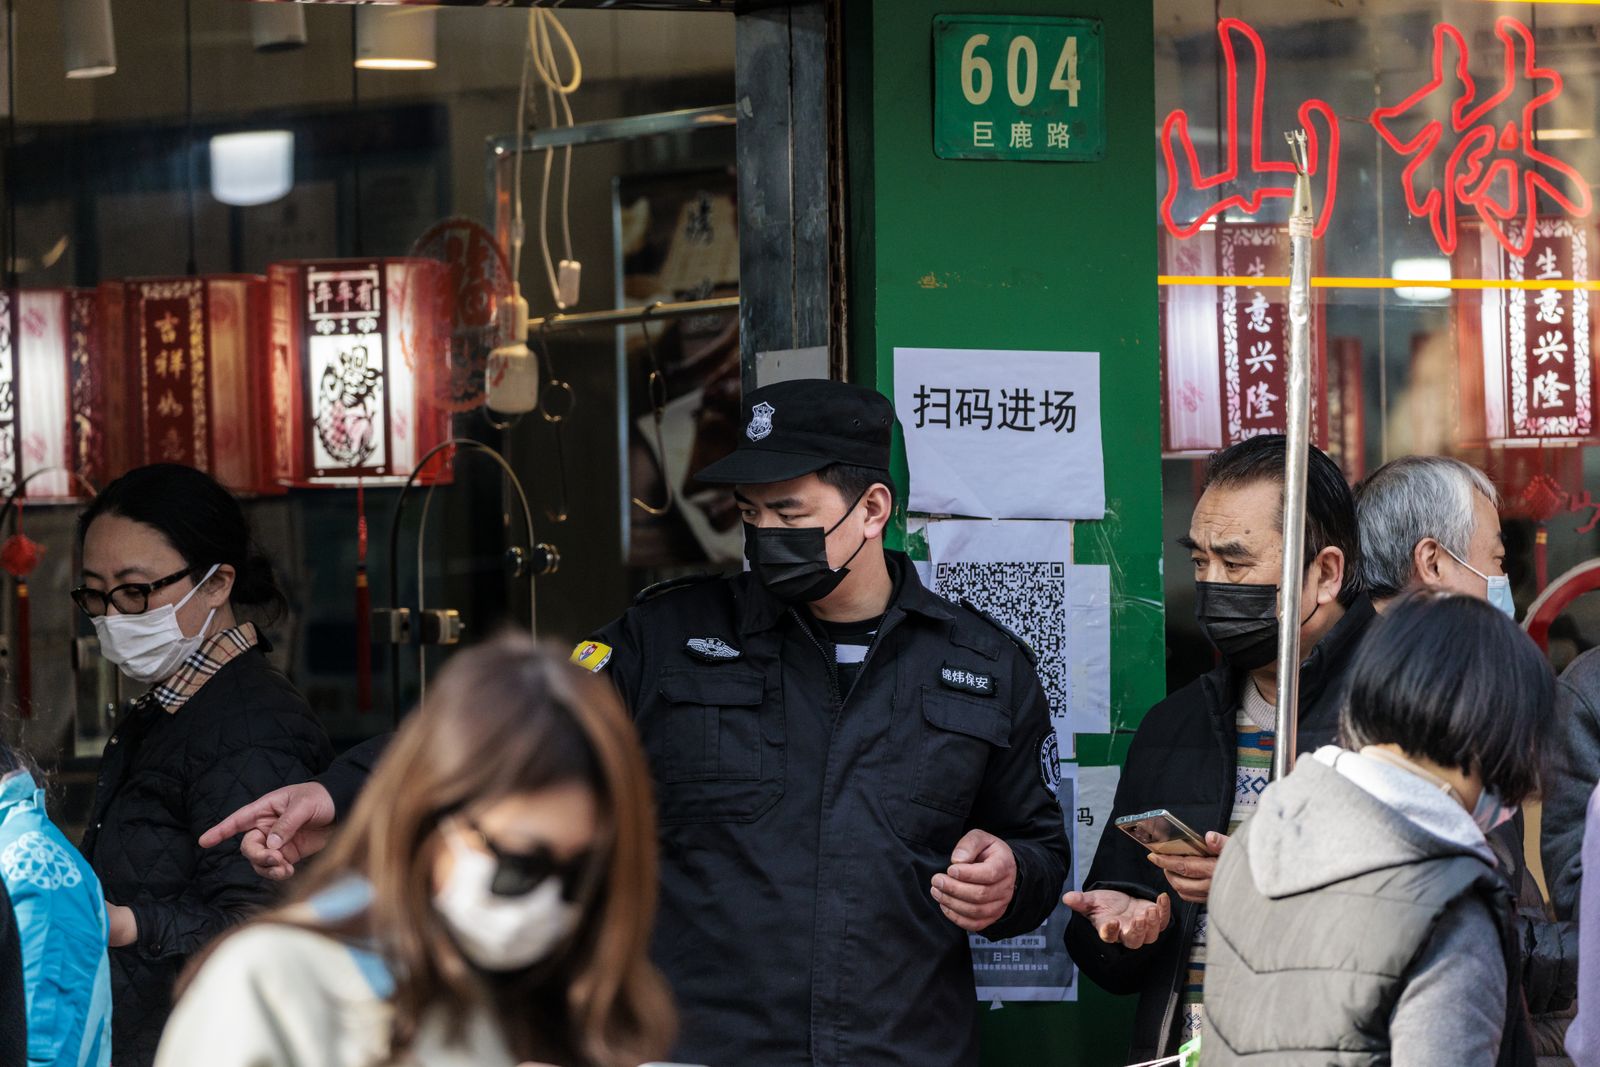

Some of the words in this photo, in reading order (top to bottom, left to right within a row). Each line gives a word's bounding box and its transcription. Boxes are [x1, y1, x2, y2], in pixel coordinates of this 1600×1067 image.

[961, 33, 1081, 107] 604
[973, 121, 1070, 149] 巨鹿路
[1532, 247, 1570, 409] 生意兴隆
[154, 309, 186, 461] 吉祥如意
[913, 384, 1077, 434] 扫码进场
[992, 951, 1021, 962] 扫一扫
